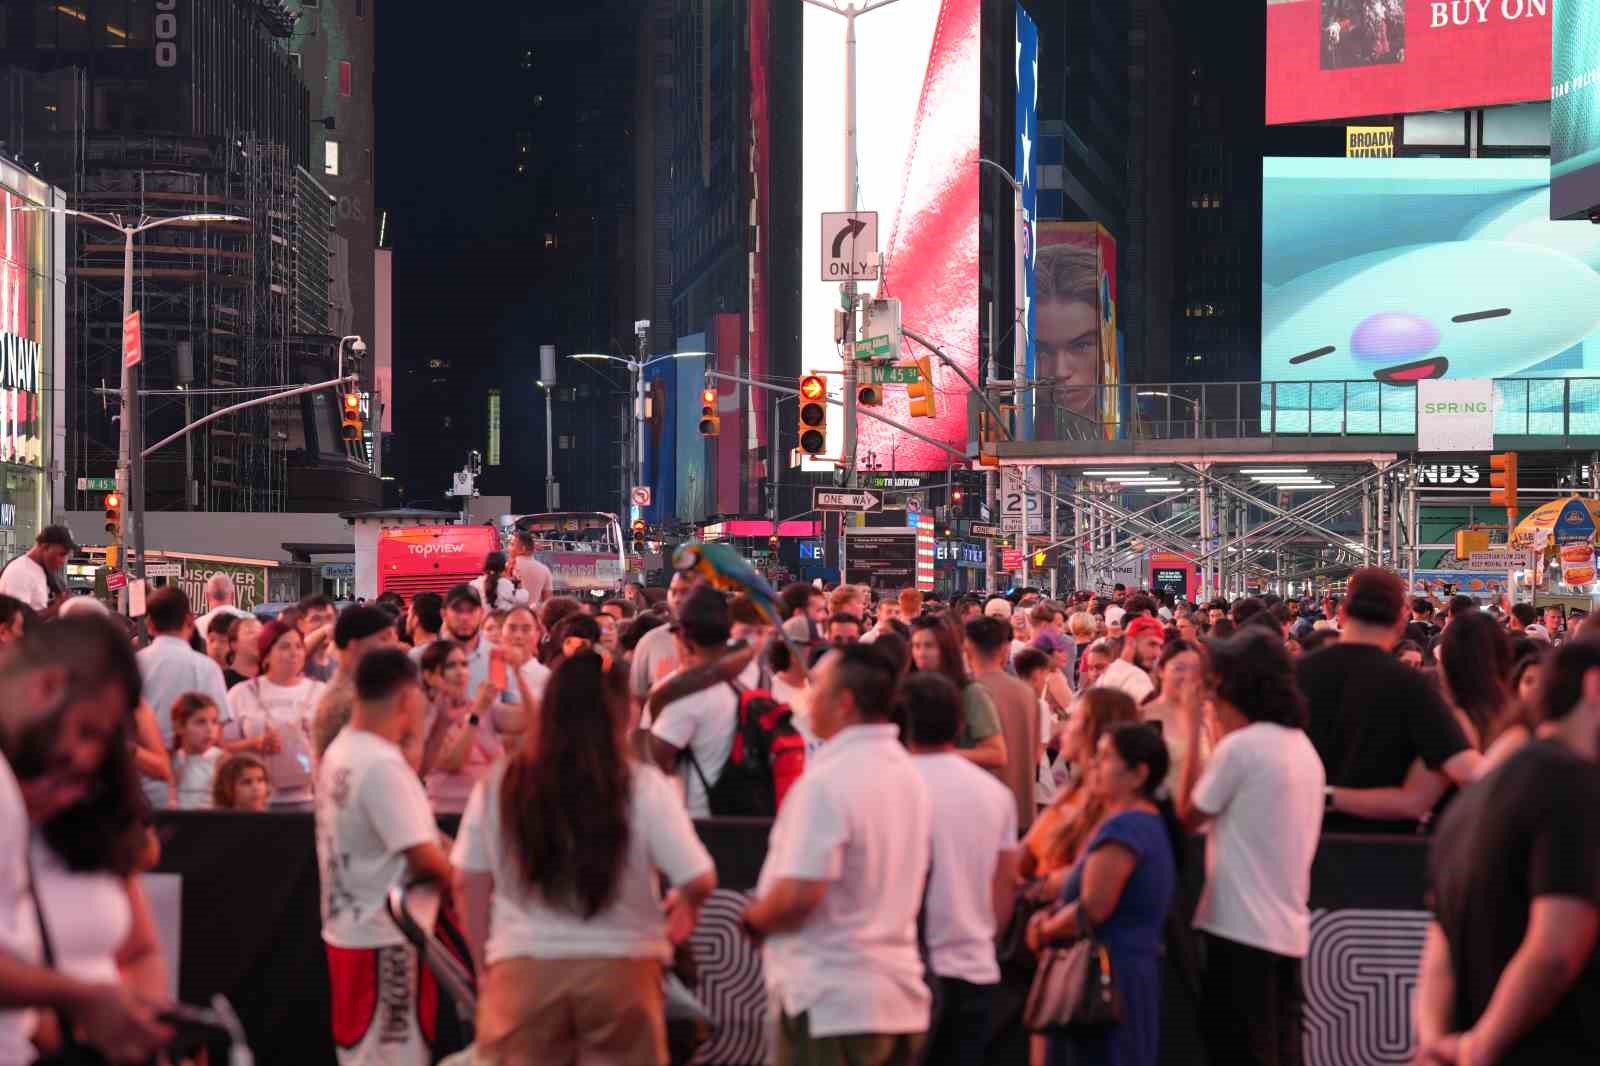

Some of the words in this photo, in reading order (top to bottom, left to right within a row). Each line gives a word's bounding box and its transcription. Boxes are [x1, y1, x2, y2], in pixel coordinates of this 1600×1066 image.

[1430, 0, 1490, 28] BUY
[830, 262, 867, 275] ONLY
[7, 330, 41, 394] NAVY
[874, 368, 884, 382] W
[890, 368, 904, 382] 45
[1424, 402, 1487, 414] SPRING
[824, 494, 843, 505] ONE
[852, 495, 872, 505] WAY
